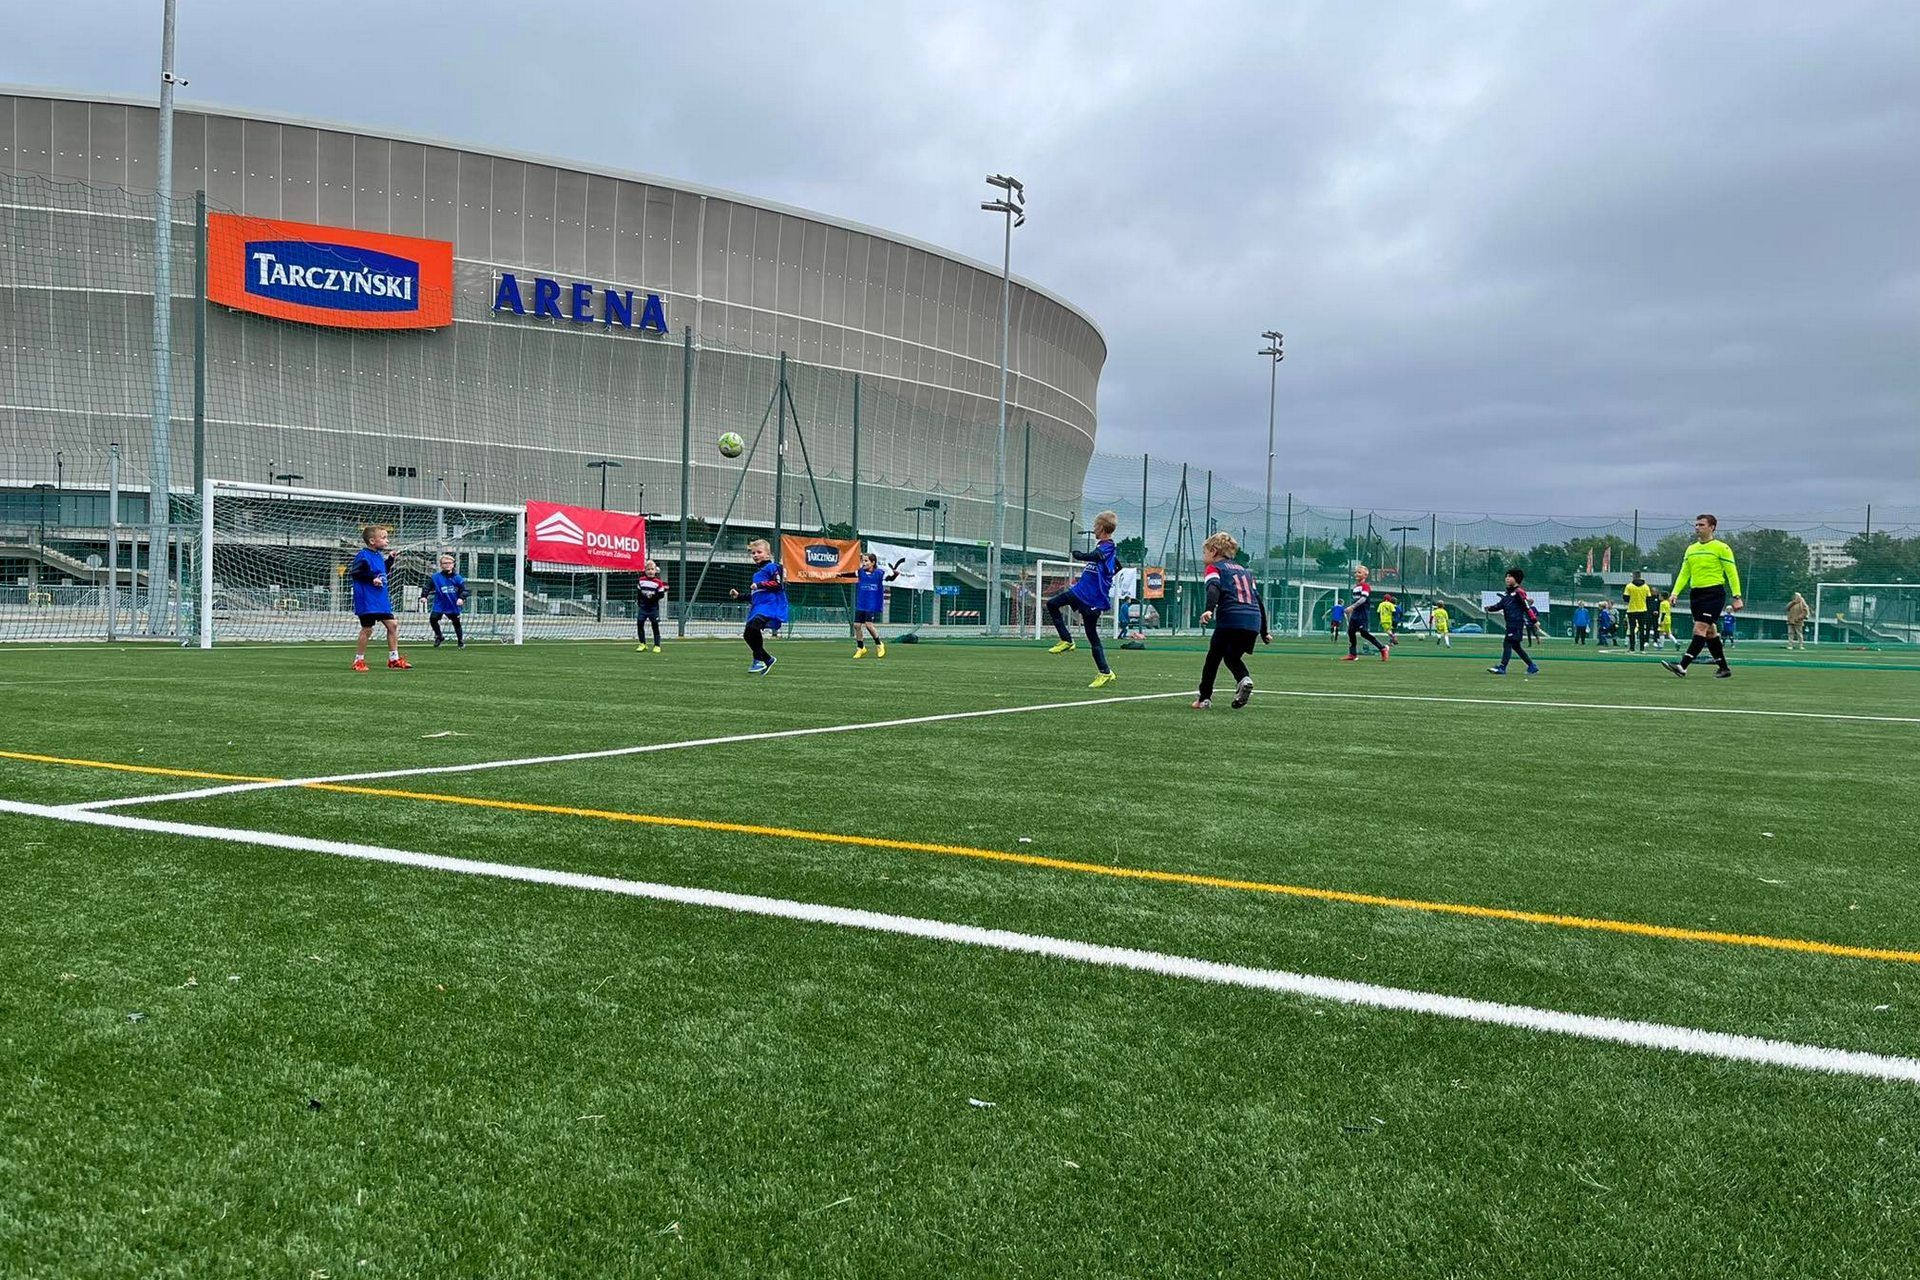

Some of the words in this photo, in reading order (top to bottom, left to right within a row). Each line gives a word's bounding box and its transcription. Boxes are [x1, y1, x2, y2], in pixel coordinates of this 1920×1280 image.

[253, 252, 412, 300] TARCZYŃSKI
[492, 273, 669, 333] ARENA
[586, 531, 640, 553] DOLMED
[1232, 574, 1252, 604] 11
